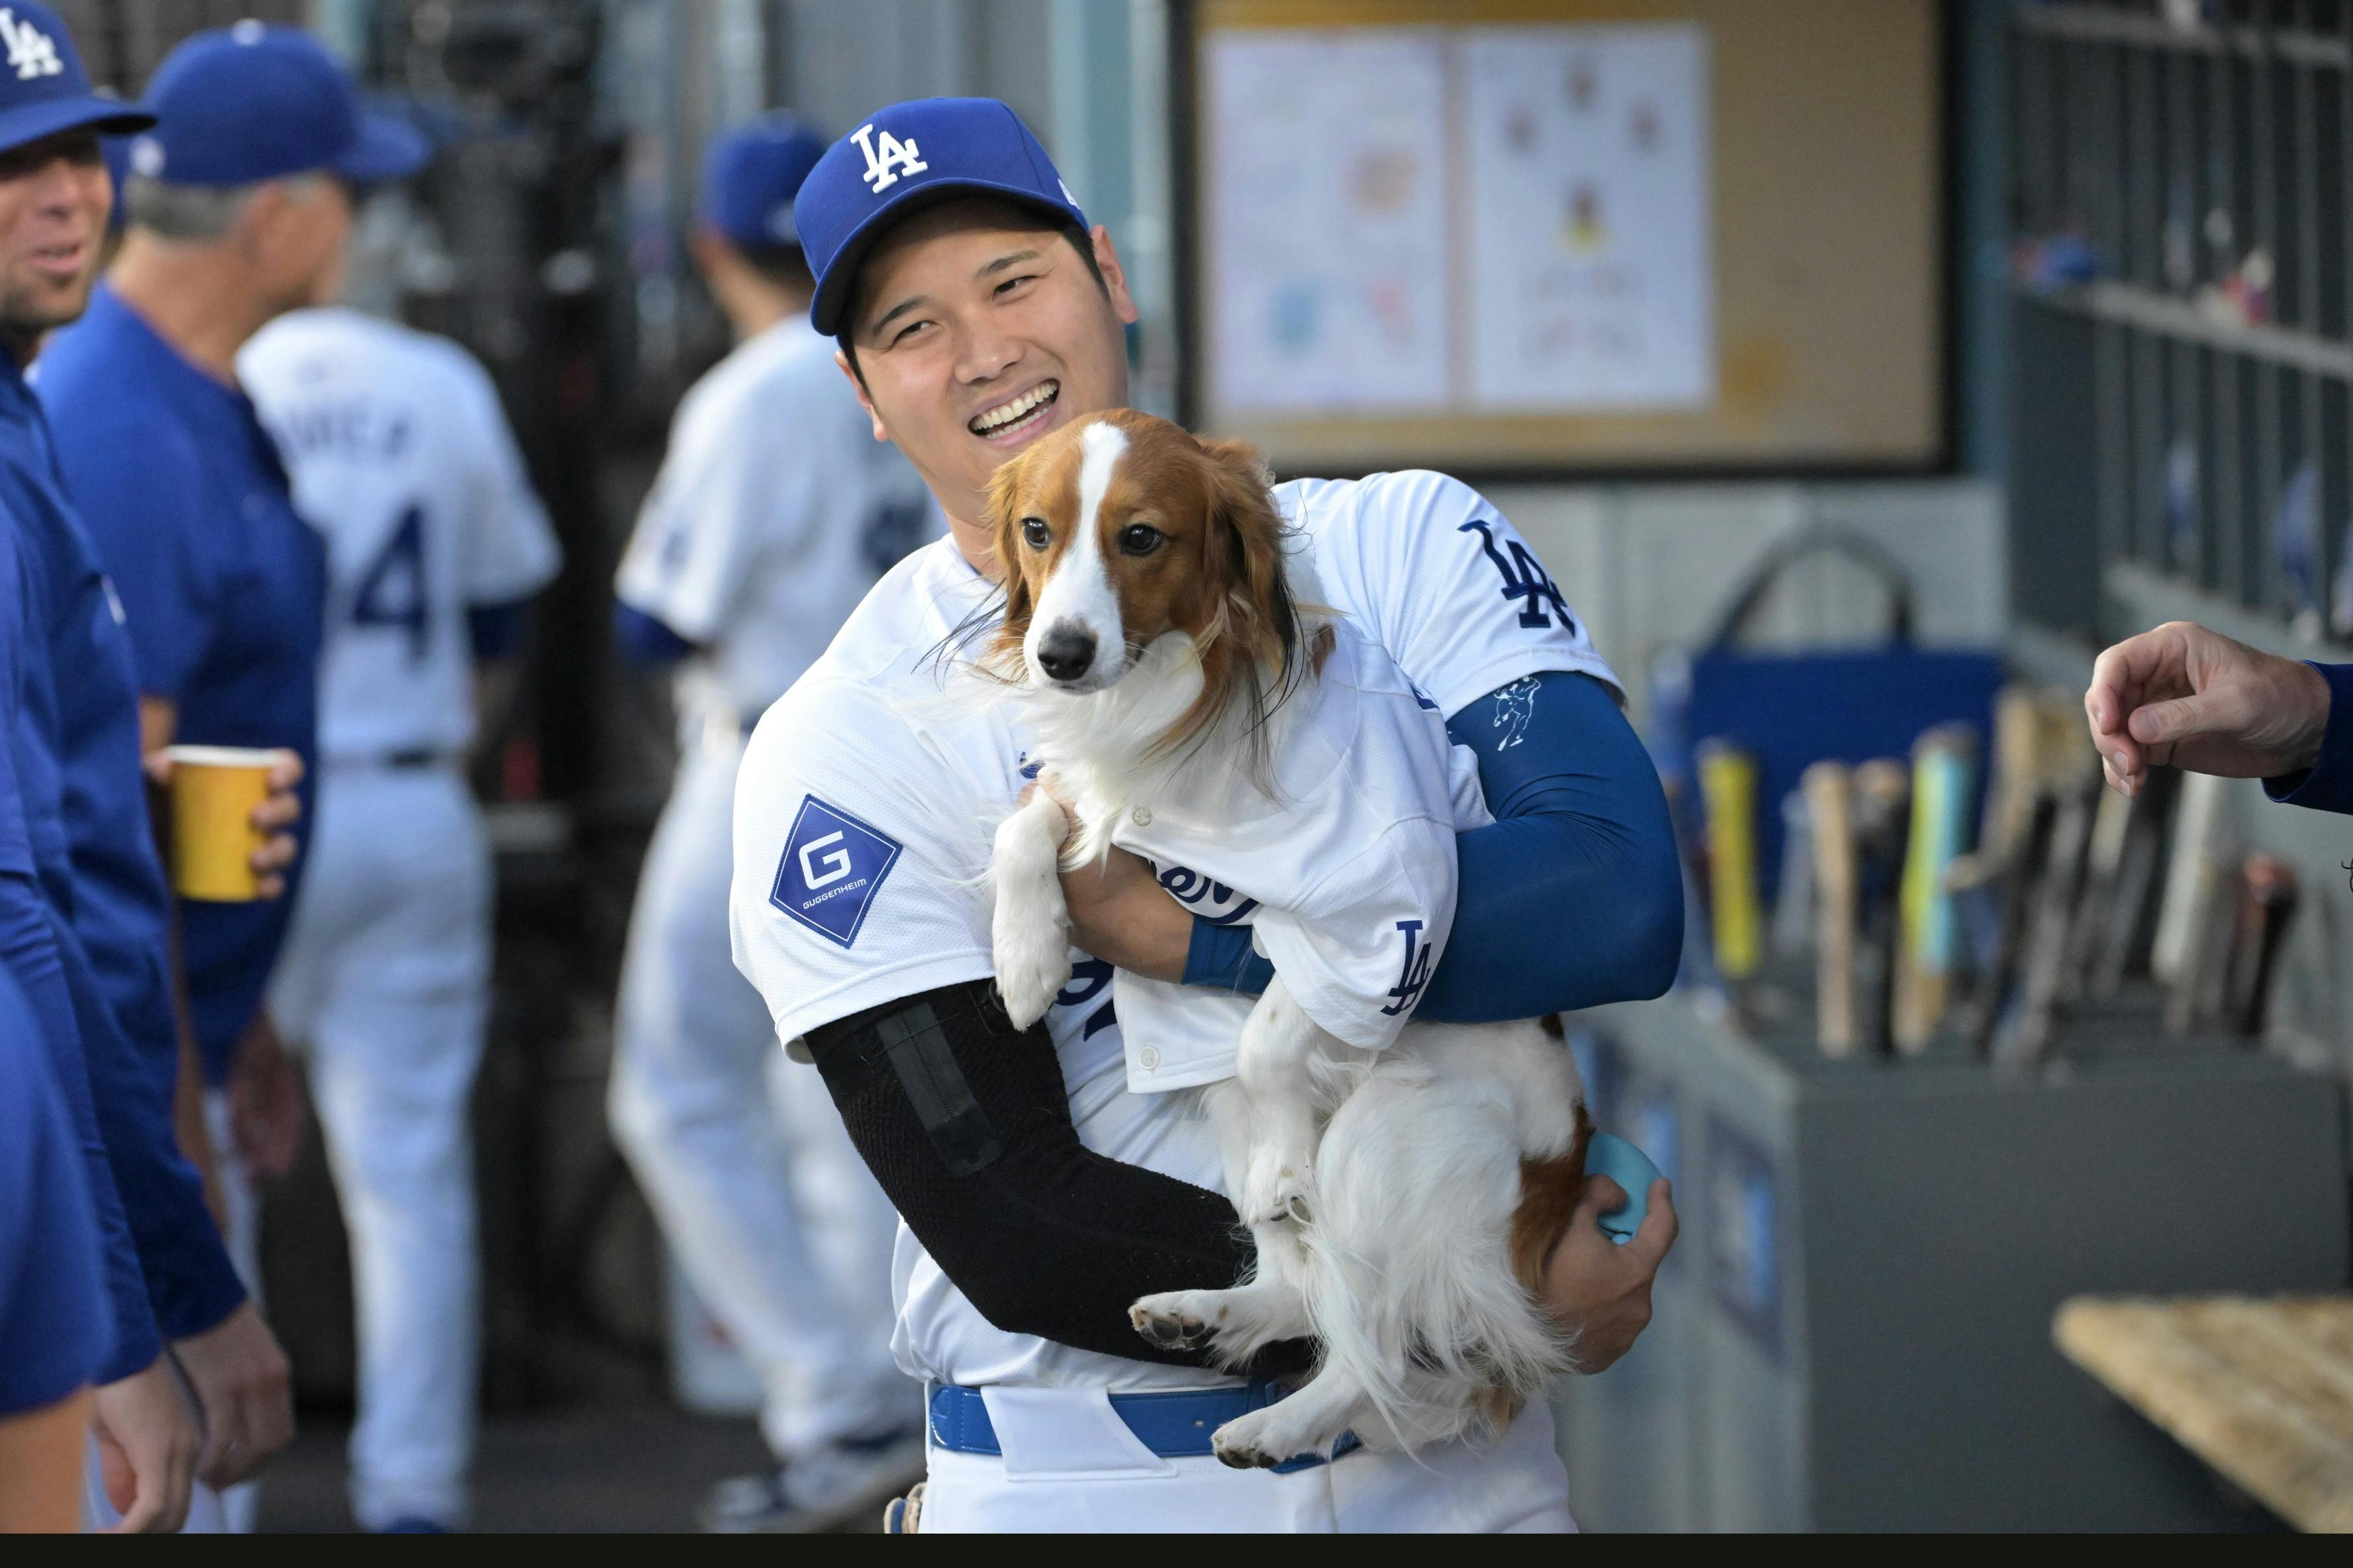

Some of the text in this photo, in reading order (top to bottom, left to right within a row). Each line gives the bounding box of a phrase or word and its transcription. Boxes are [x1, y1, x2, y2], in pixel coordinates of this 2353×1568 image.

[0, 7, 64, 80] LA
[850, 123, 928, 193] LA
[353, 501, 430, 660] 4
[1457, 519, 1576, 638] LA
[799, 830, 852, 890] G
[803, 878, 867, 910] GUGGENHEIM
[1380, 920, 1432, 1016] LA
